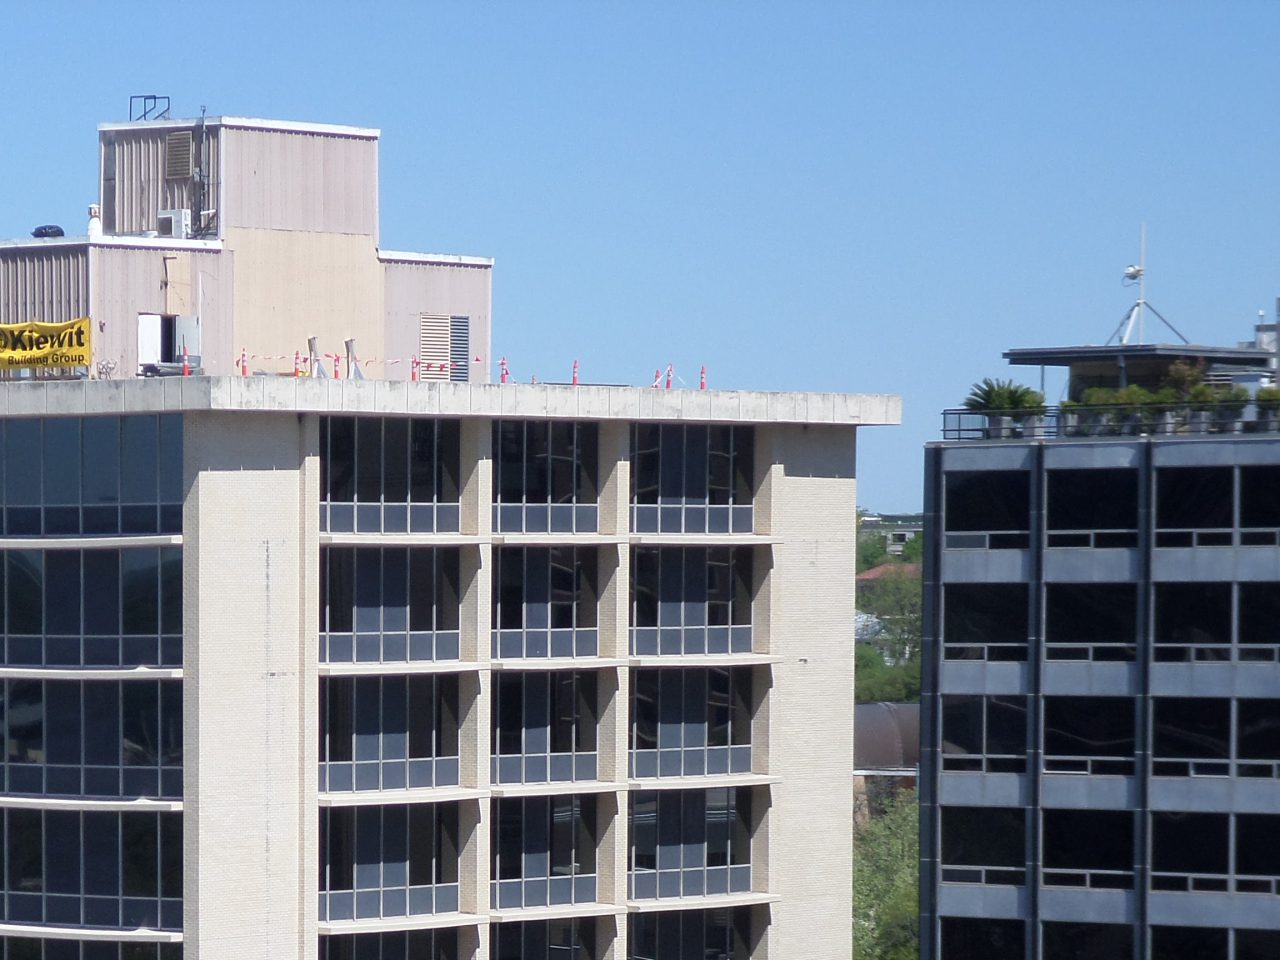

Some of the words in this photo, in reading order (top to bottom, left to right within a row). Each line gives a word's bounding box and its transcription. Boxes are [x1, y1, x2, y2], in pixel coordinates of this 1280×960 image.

[10, 325, 85, 351] Kiewit
[8, 355, 49, 365] Building
[51, 353, 85, 364] Group
